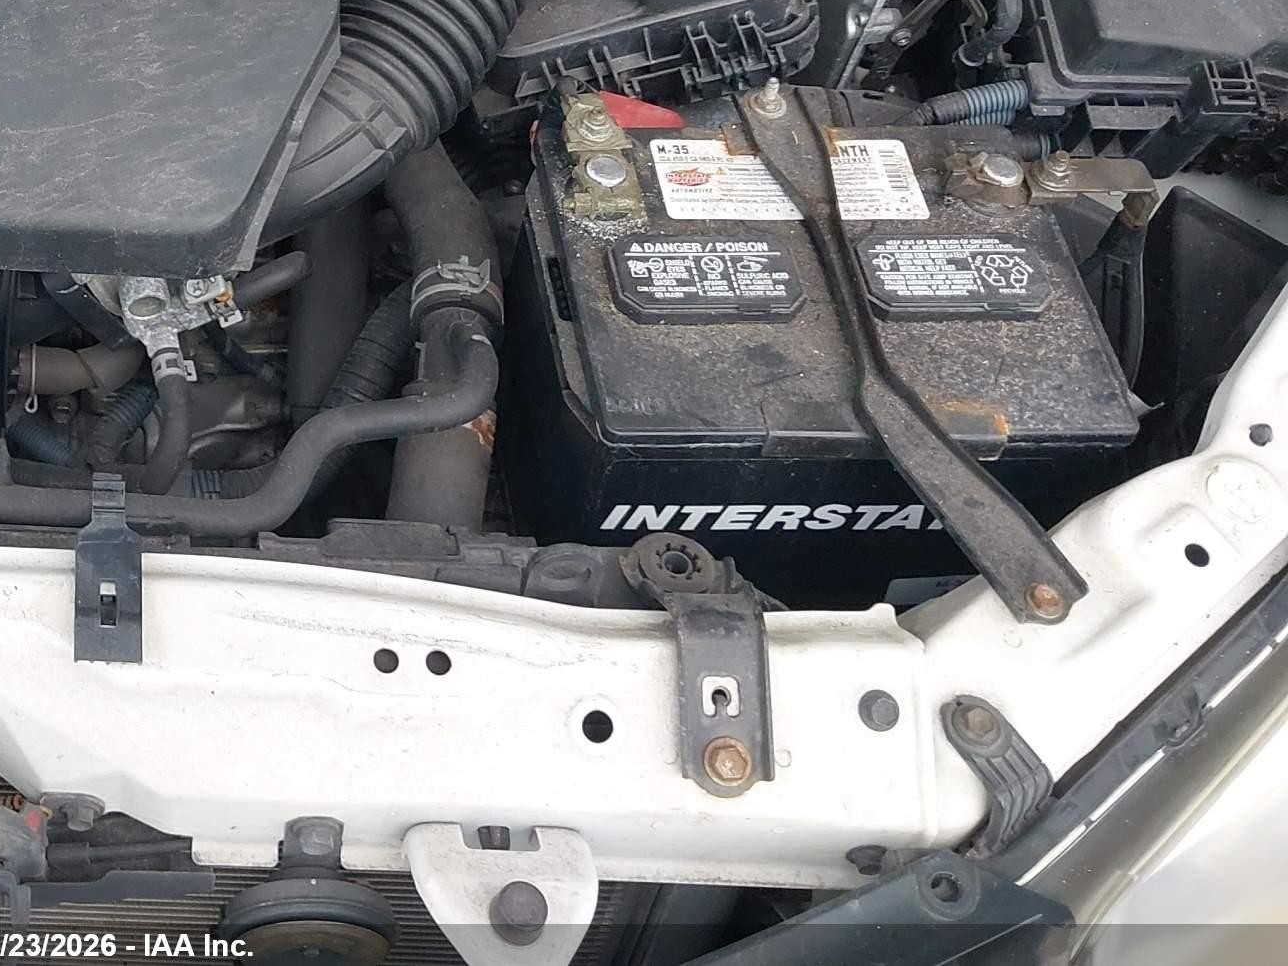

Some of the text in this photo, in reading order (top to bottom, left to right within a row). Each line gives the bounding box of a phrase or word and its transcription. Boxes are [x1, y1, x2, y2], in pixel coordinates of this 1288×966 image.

[657, 144, 690, 155] M-35
[838, 144, 870, 157] NTH
[643, 242, 703, 253] DANGER
[715, 242, 769, 252] POISON
[600, 504, 946, 531] INTERSTA
